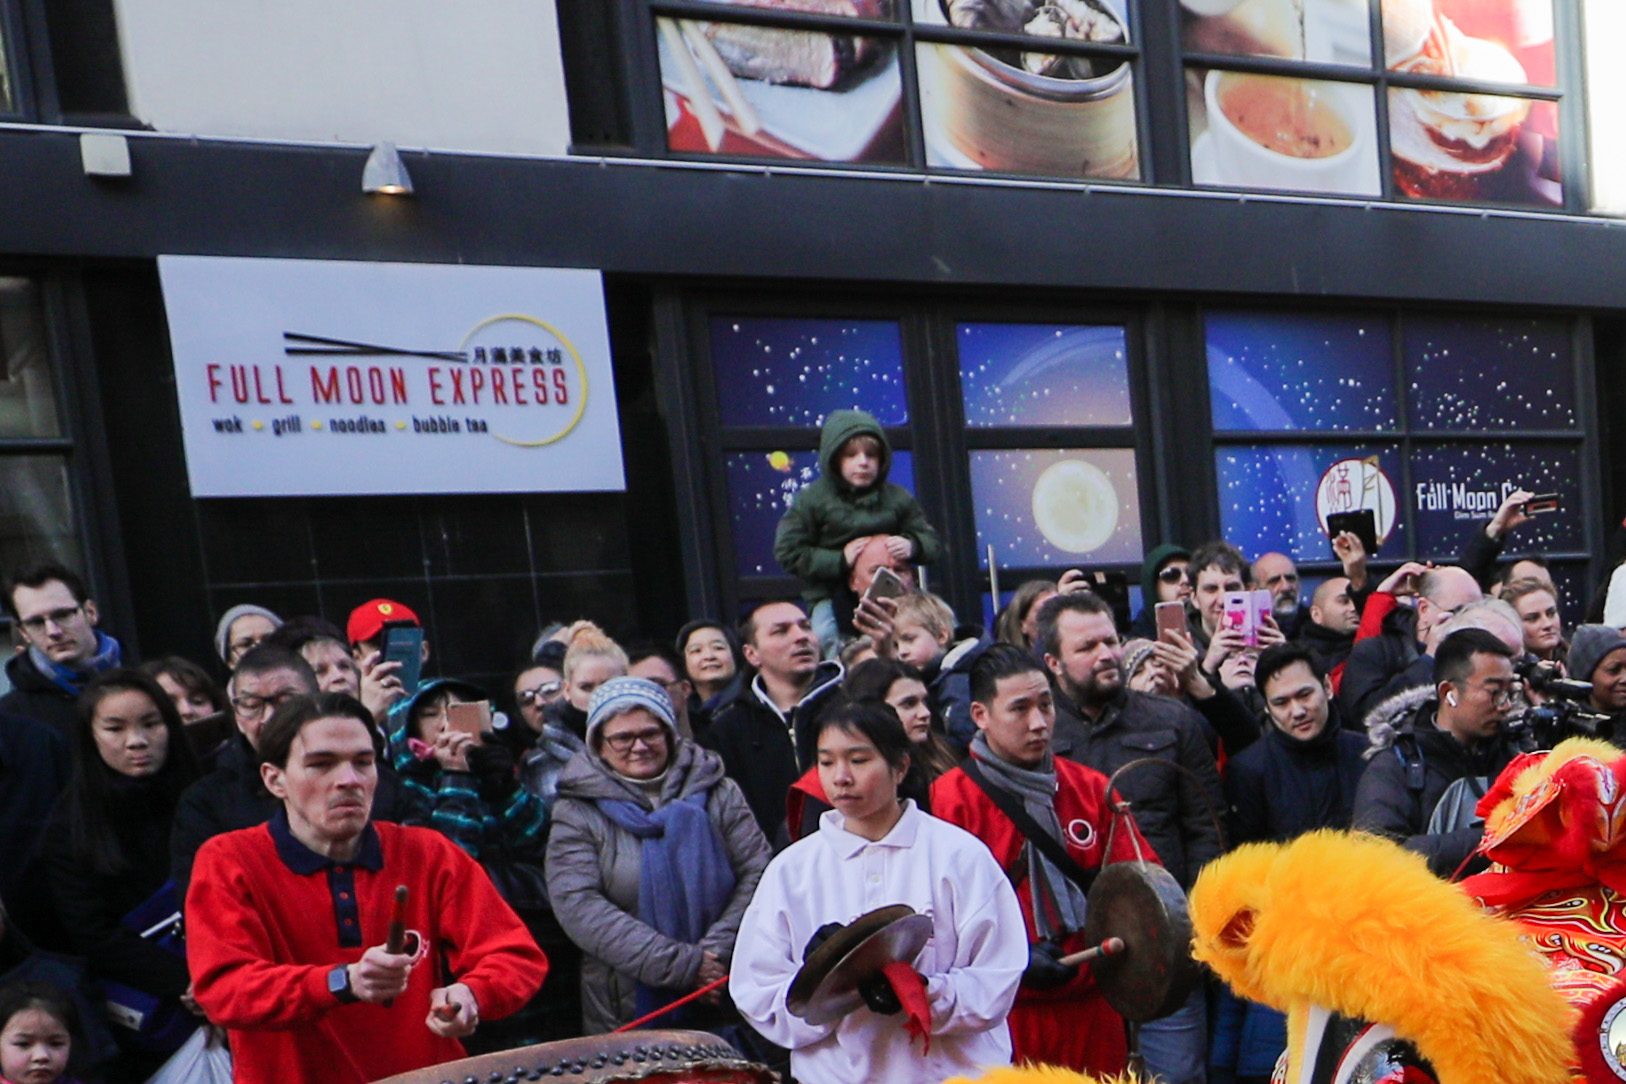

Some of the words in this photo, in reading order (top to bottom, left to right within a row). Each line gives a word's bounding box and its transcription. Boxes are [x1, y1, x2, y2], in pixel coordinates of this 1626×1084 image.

[207, 364, 293, 406] FULL
[310, 365, 408, 406] MOON
[428, 366, 569, 406] EXPRESS
[211, 414, 243, 433] wok
[272, 414, 302, 437] grill
[329, 416, 386, 434] noodles
[412, 414, 460, 434] bubble
[465, 416, 488, 434] tea
[1452, 482, 1497, 512] Moon
